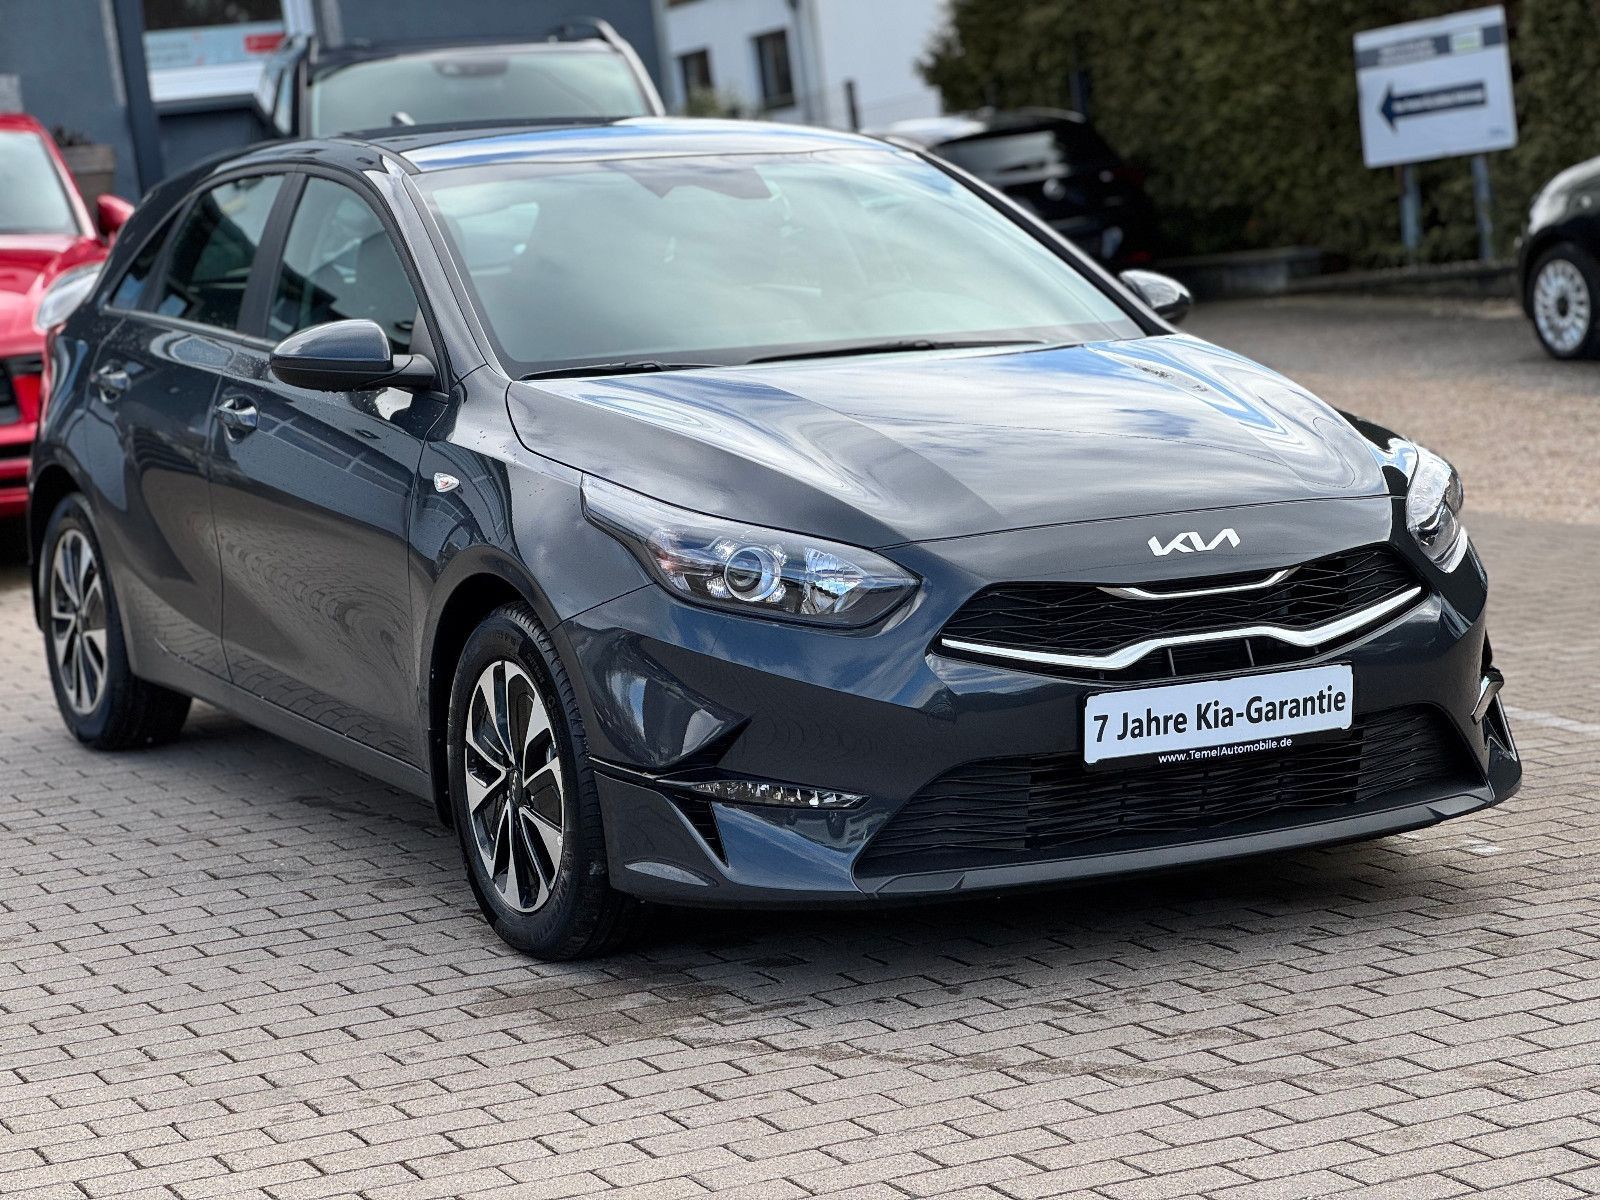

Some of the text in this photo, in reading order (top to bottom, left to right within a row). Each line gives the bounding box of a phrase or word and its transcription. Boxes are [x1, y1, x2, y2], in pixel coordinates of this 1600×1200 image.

[1147, 528, 1240, 556] KIA
[1093, 685, 1346, 742] 7 Jahre Kia-Garantie
[1158, 737, 1292, 763] www.TemelAutomobile.de
